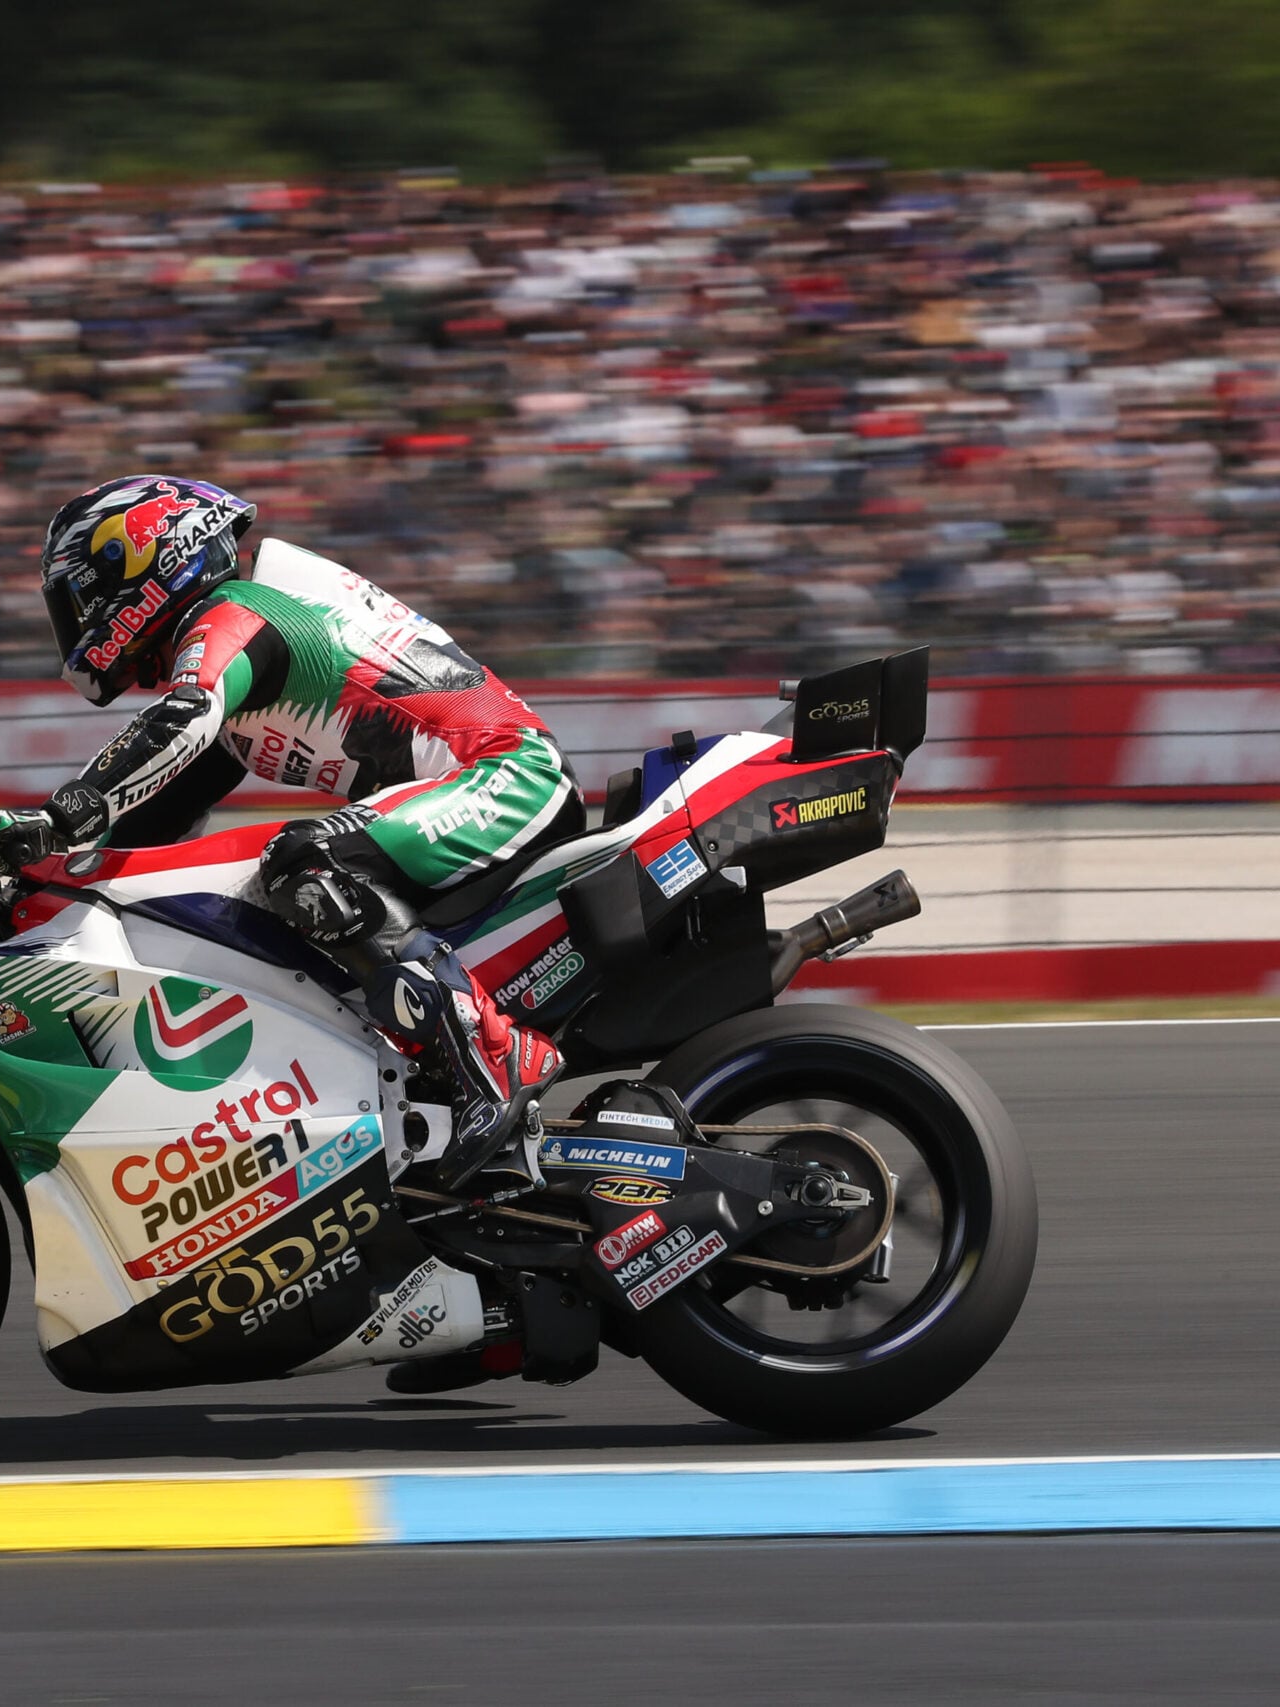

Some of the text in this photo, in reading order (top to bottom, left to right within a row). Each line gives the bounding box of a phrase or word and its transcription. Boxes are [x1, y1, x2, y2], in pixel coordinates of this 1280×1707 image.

[160, 498, 235, 576] SHARK
[85, 579, 170, 672] Red Bull
[253, 726, 287, 782] strol
[646, 839, 698, 886] ES
[495, 937, 573, 1007] flow-meter
[533, 957, 579, 1001] DRACO
[112, 1058, 319, 1206] Castrol
[600, 1113, 671, 1127] FINTECH MEDIA
[568, 1147, 671, 1168] MICHELIN
[145, 1190, 287, 1276] HONDA
[620, 1214, 656, 1244] MIW
[626, 1223, 660, 1250] FILTERS
[239, 1246, 361, 1336] SPORTS
[376, 1285, 412, 1323] VILLAGE
[406, 1260, 438, 1290] MOTOS
[613, 1252, 653, 1285] NGK
[648, 1235, 724, 1295] FEDEGARI
